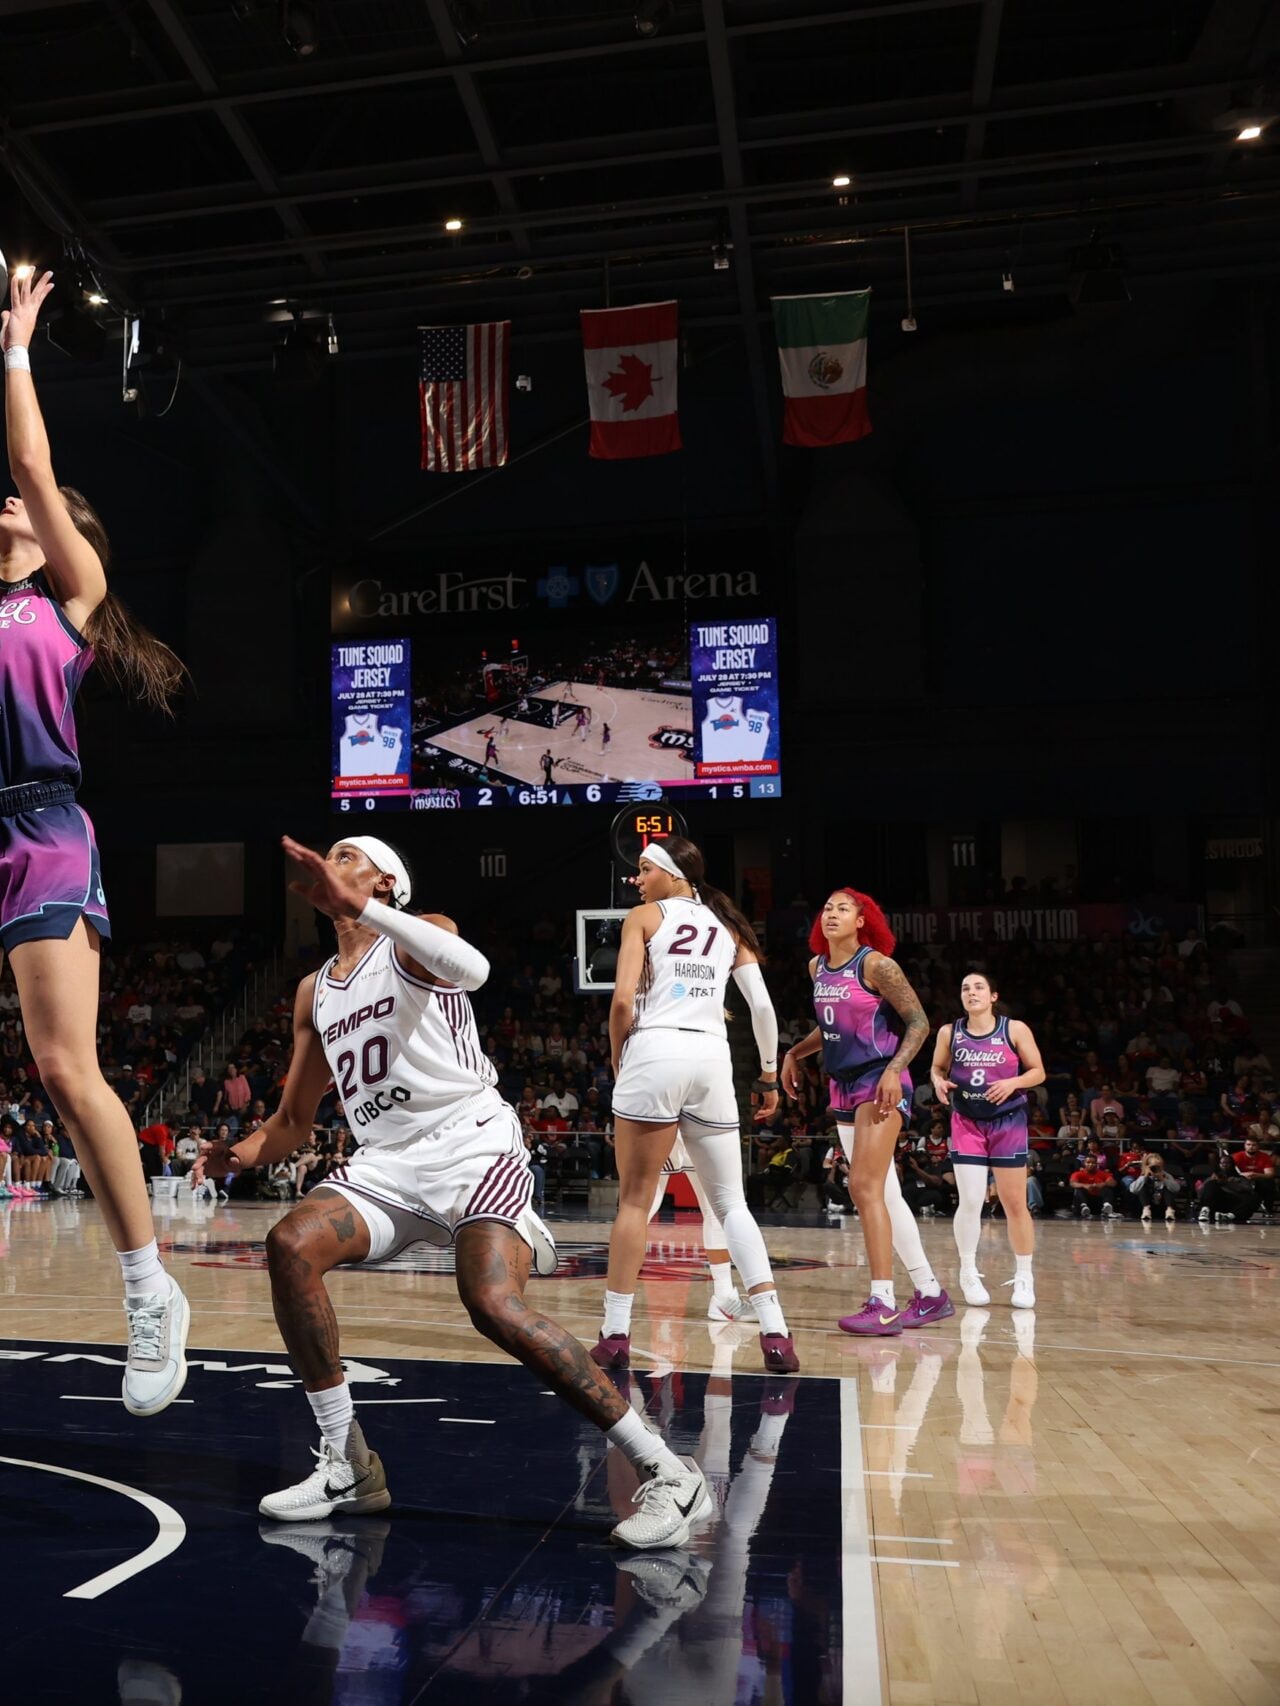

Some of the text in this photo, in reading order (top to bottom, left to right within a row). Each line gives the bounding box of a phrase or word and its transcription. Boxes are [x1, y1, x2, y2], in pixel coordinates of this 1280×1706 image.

[349, 560, 760, 619] CareFirst Arena
[697, 624, 769, 648] TUNE SQUAD
[338, 645, 403, 667] TUNE SQUAD
[712, 648, 756, 670] JERSEY
[351, 667, 391, 689] JERSEY
[698, 674, 717, 682] JULY
[728, 673, 740, 681] AT
[337, 692, 355, 700] JULY
[748, 720, 762, 734] 98
[383, 736, 396, 749] 98
[701, 763, 772, 774] mystics.wnba.com
[339, 777, 404, 787] mystics.wnba.com
[341, 800, 350, 811] 5
[365, 799, 375, 811] 0
[478, 788, 493, 805] 2
[519, 790, 558, 805] 6:51
[586, 785, 601, 802] 6
[709, 786, 717, 799] 1
[733, 785, 744, 798] 5
[758, 784, 775, 794] 13
[636, 816, 672, 833] 6:51
[952, 842, 976, 867] 111
[480, 855, 507, 878] 110
[947, 911, 984, 942] THE
[993, 909, 1078, 941] RHYTHM
[668, 924, 718, 956] 21
[674, 962, 715, 980] HARRISON
[688, 987, 716, 998] AT&T
[813, 981, 851, 999] District
[323, 996, 395, 1046] TEMPO
[823, 1005, 834, 1026] 0
[954, 1047, 1006, 1064] District
[337, 1035, 390, 1101] 20
[970, 1069, 985, 1087] 8
